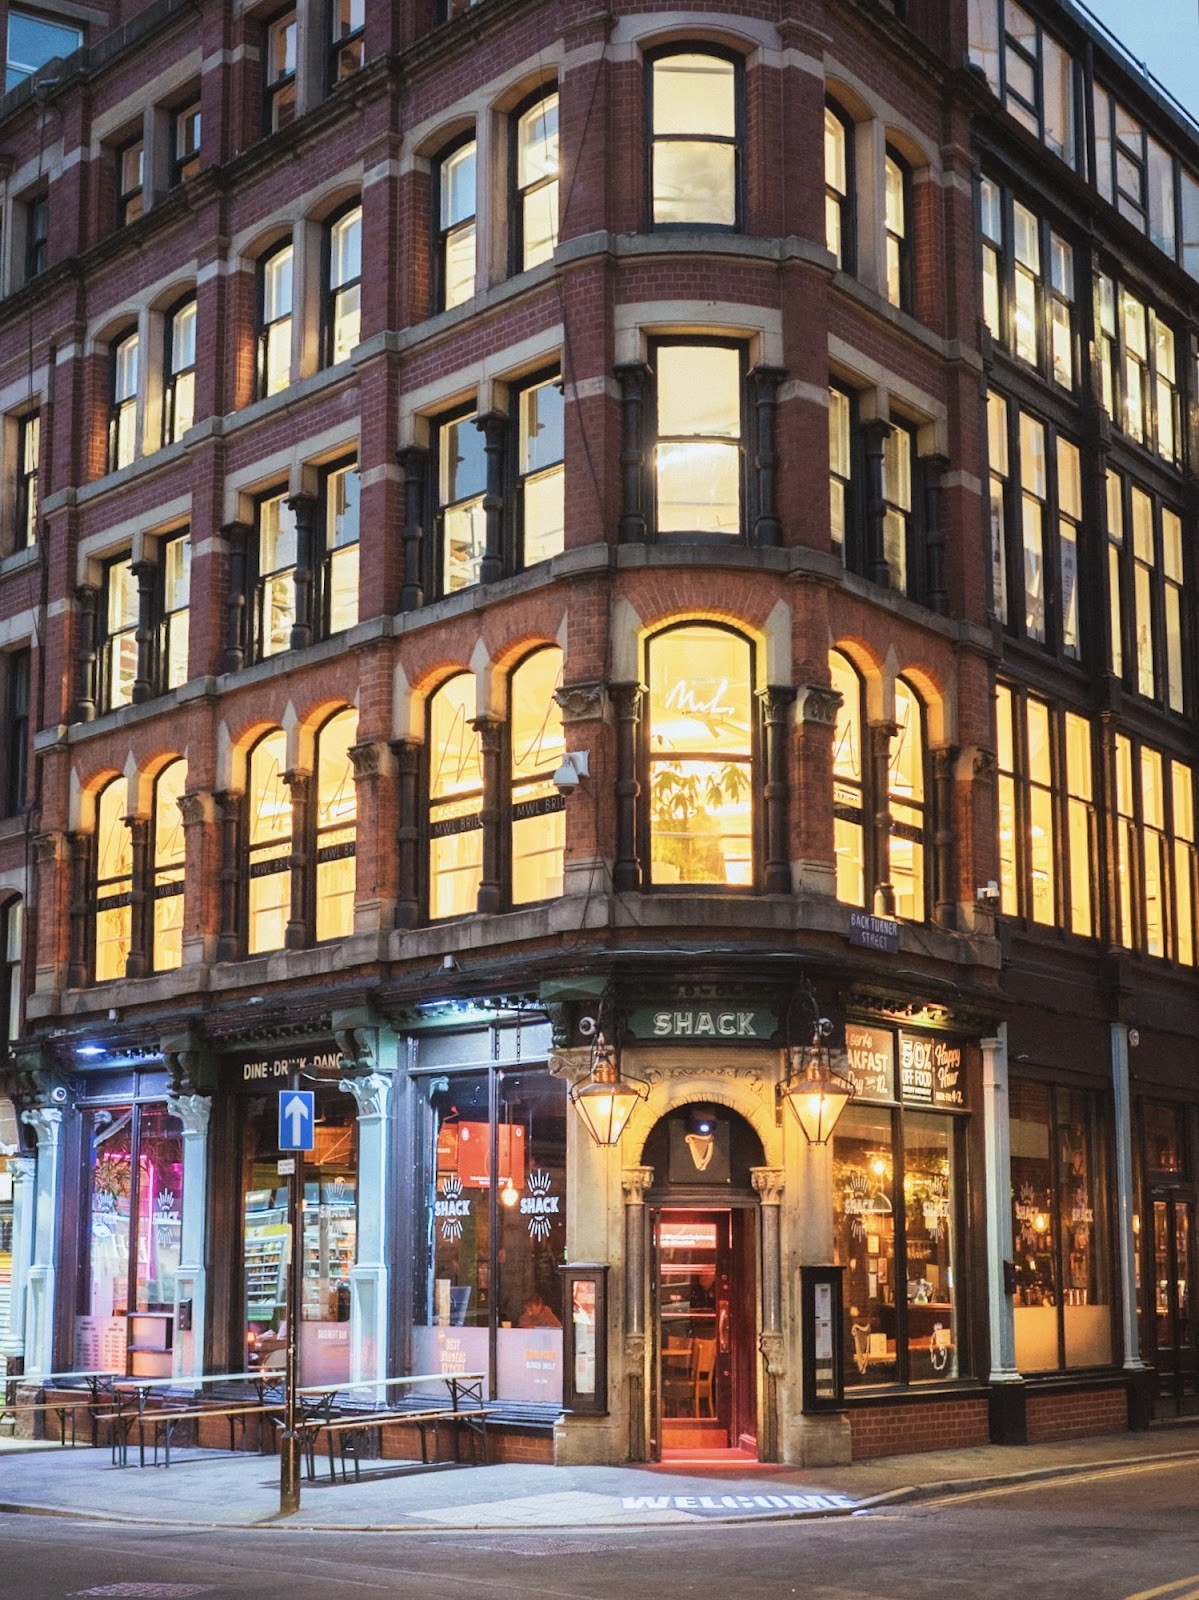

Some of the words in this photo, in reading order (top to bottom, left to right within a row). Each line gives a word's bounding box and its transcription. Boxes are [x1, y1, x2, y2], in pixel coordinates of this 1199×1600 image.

[850, 913, 870, 929] BACK
[871, 917, 898, 936] TURNER
[861, 931, 888, 950] STREET
[653, 1011, 757, 1036] SHACK
[934, 1042, 961, 1068] Happy
[243, 1062, 268, 1080] DINE
[273, 1057, 307, 1077] DRK
[901, 1068, 915, 1085] OFF
[915, 1070, 932, 1087] FOOD
[937, 1066, 959, 1089] Hour
[435, 1200, 470, 1216] SHACK
[519, 1197, 559, 1214] SHACK
[622, 1494, 858, 1509] WELCOME
